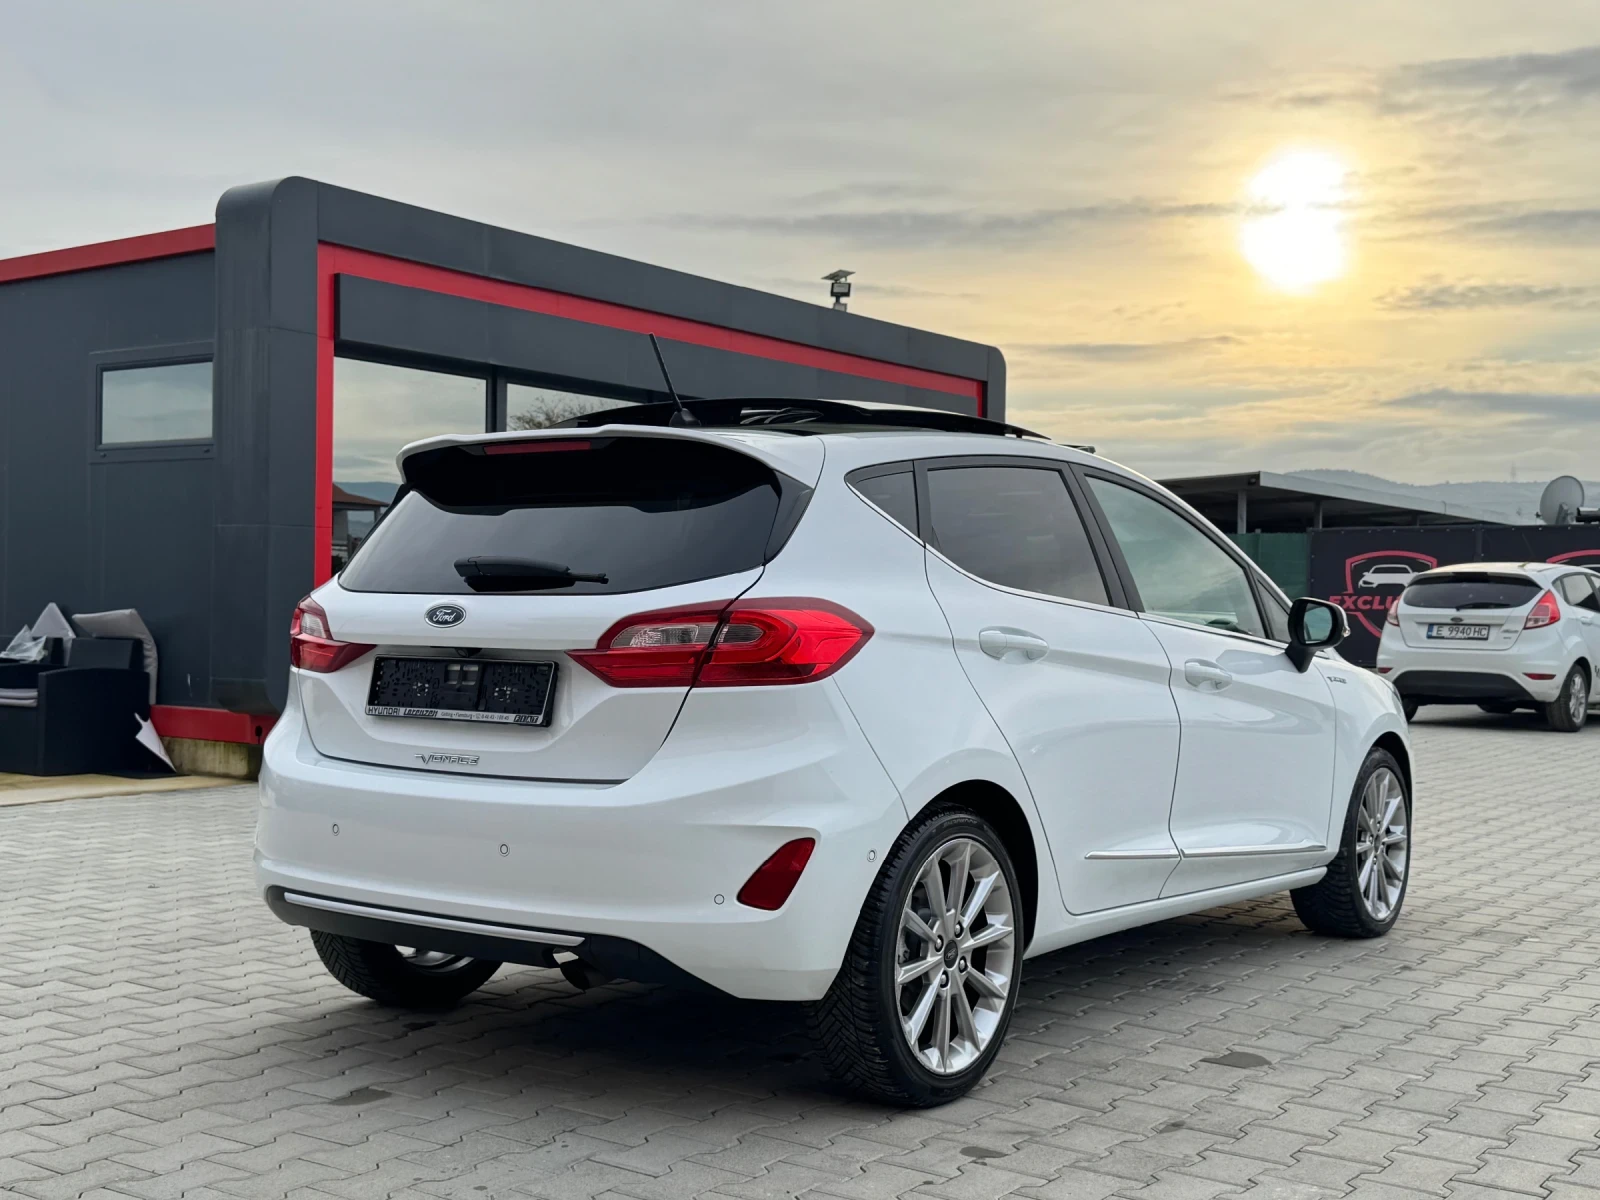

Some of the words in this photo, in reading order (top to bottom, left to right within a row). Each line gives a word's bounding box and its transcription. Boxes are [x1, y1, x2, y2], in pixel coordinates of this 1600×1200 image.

[432, 609, 457, 622] Ford
[1436, 626, 1444, 635] E
[1448, 626, 1472, 636] 9940
[1473, 627, 1487, 637] HC
[367, 706, 400, 716] HYUNDAI
[514, 714, 539, 723] FIAT
[414, 752, 480, 765] VIGNALE
